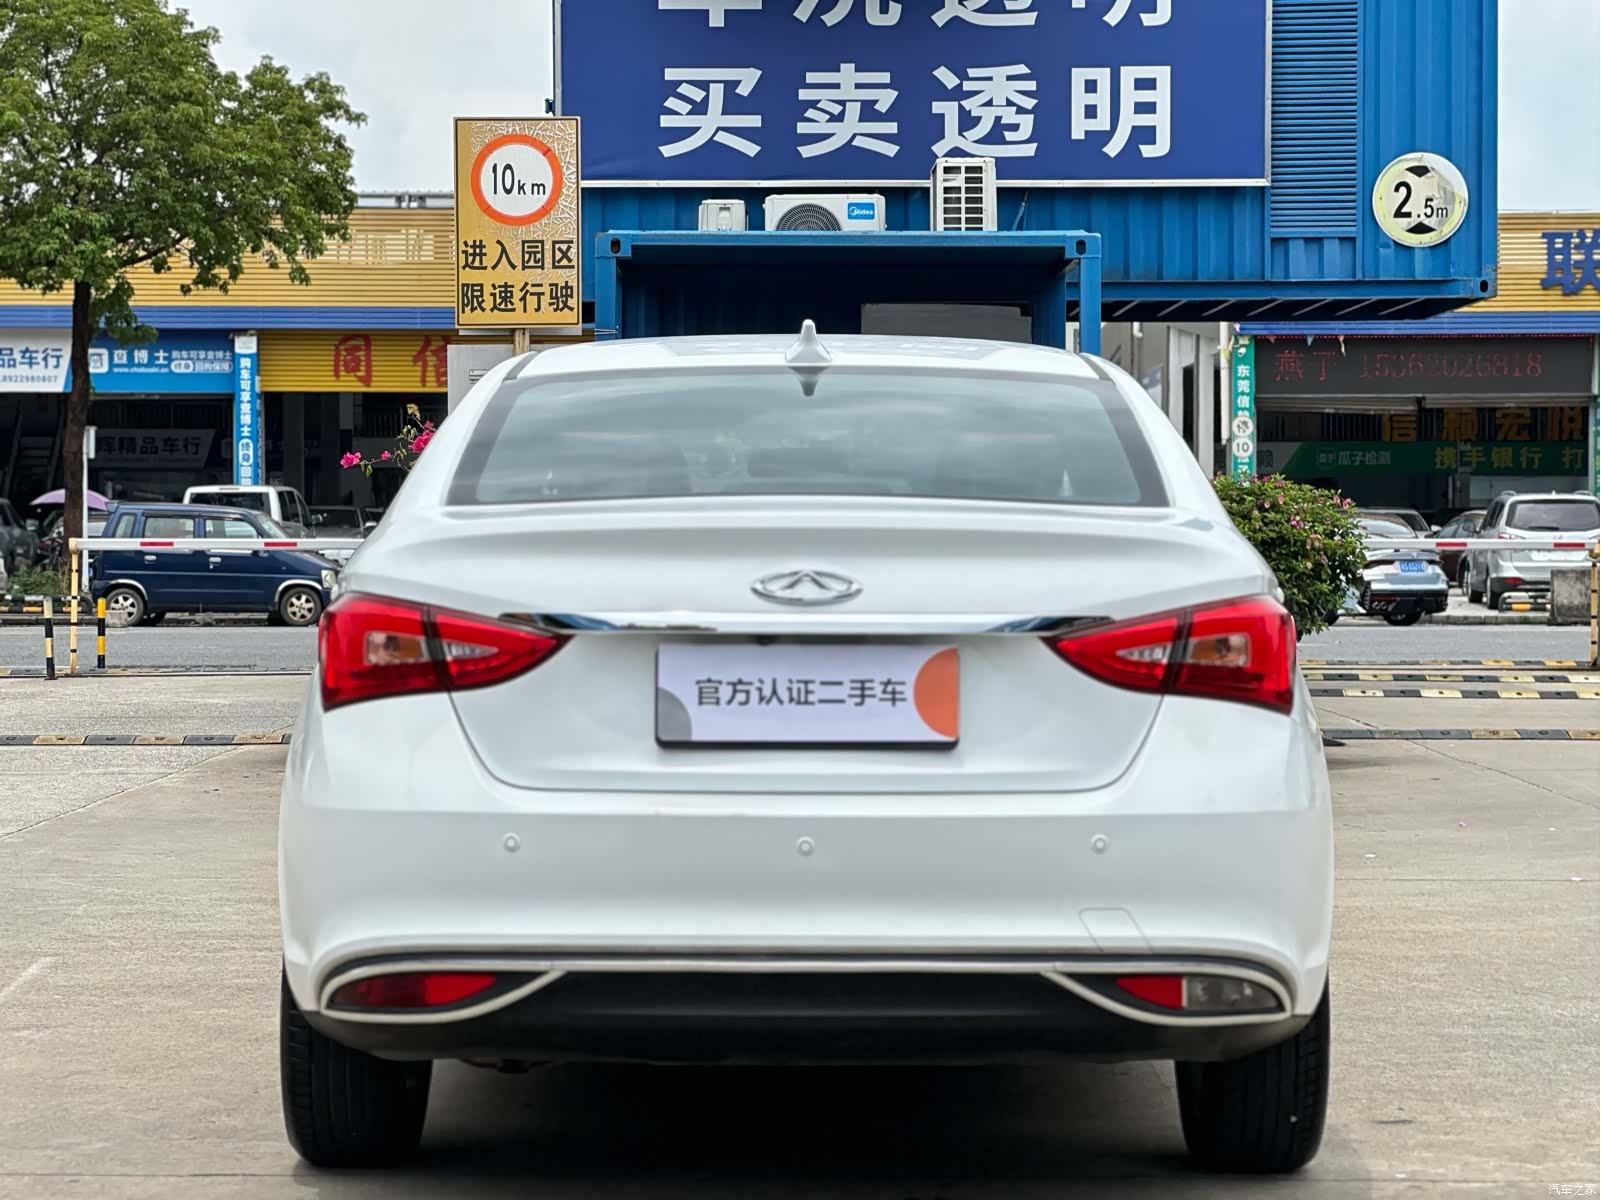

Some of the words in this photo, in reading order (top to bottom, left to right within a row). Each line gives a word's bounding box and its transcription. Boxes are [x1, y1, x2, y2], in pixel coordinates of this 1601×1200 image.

[658, 63, 1171, 158] 买卖透明
[491, 163, 546, 195] 10km
[852, 207, 874, 216] Midea
[1393, 181, 1448, 218] 2.5m
[461, 239, 575, 271] 进入园区
[1540, 228, 1600, 296] 联
[461, 281, 575, 313] 限速行驶
[0, 346, 63, 369] 品车行
[113, 349, 169, 364] 查博士
[0, 374, 58, 383] 8922980807
[1236, 442, 1250, 453] 10
[695, 677, 908, 708] 官方认证二手车
